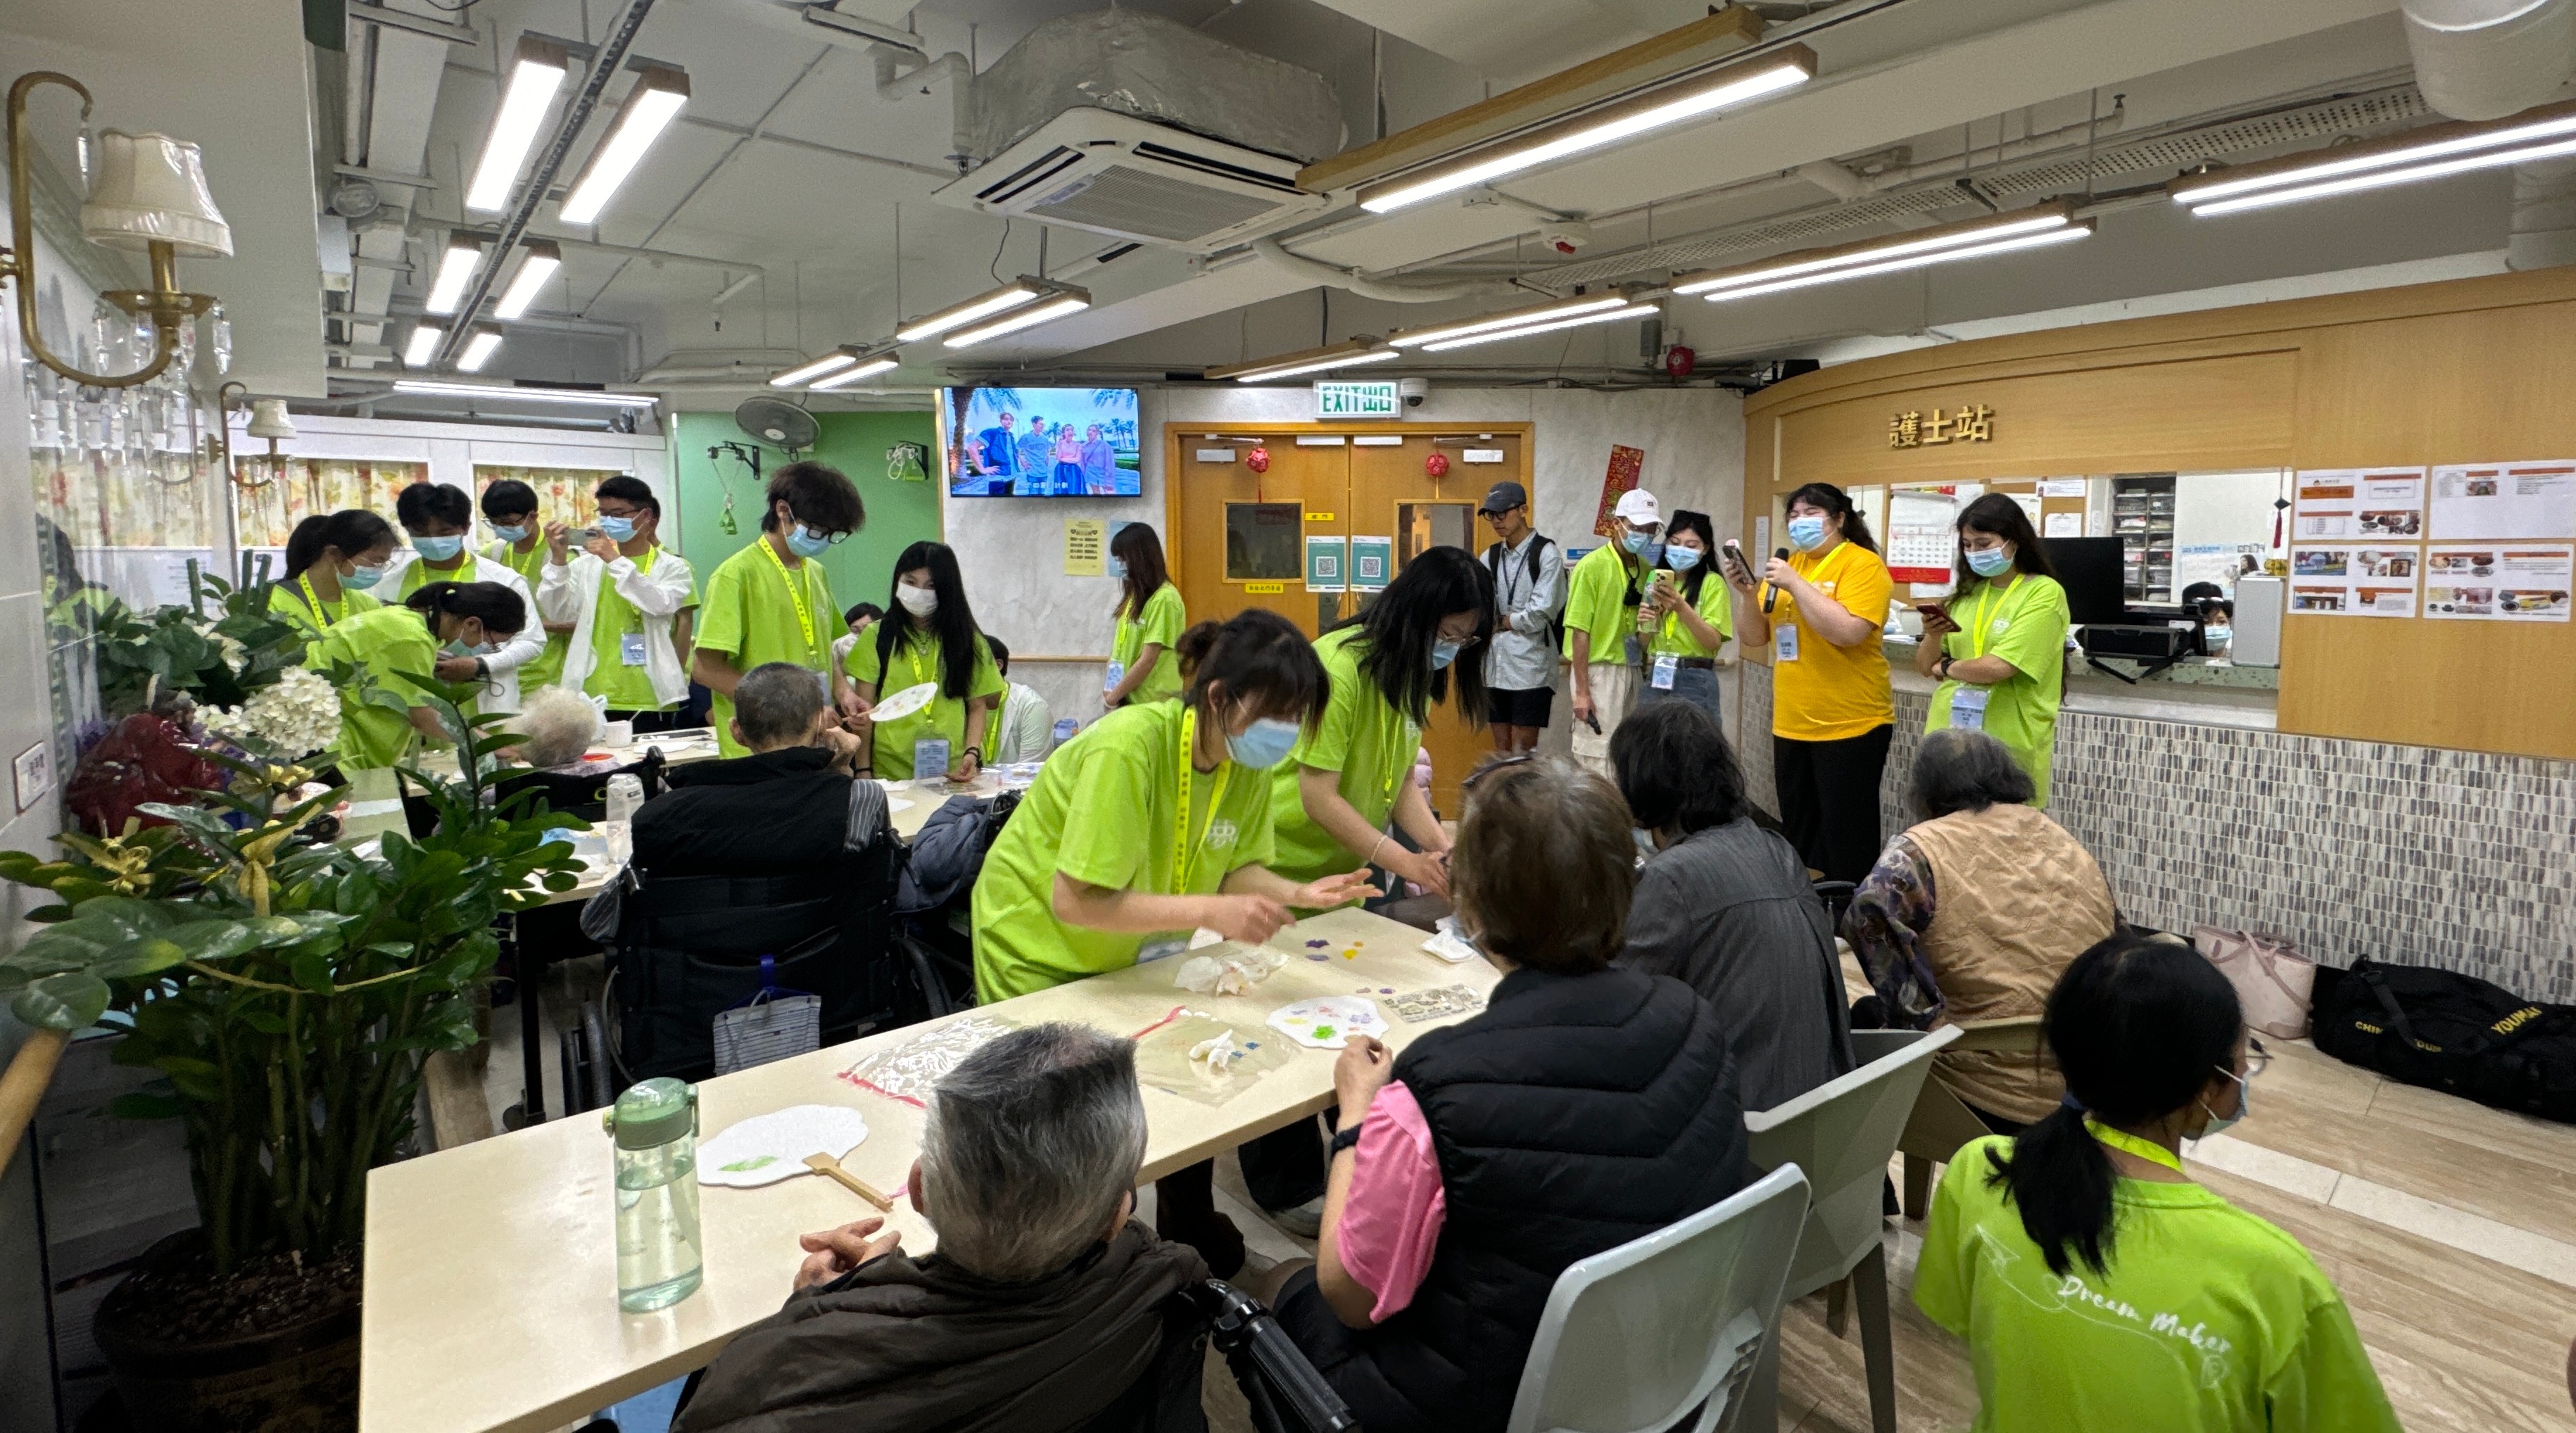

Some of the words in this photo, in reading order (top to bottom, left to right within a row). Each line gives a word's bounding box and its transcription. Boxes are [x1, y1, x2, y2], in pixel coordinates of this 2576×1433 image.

[1322, 386, 1360, 412] EXIT
[1363, 386, 1391, 412] 出口
[1889, 403, 1993, 447] 護士站
[2057, 1275, 2142, 1322] Dream
[2149, 1312, 2231, 1354] Maker
